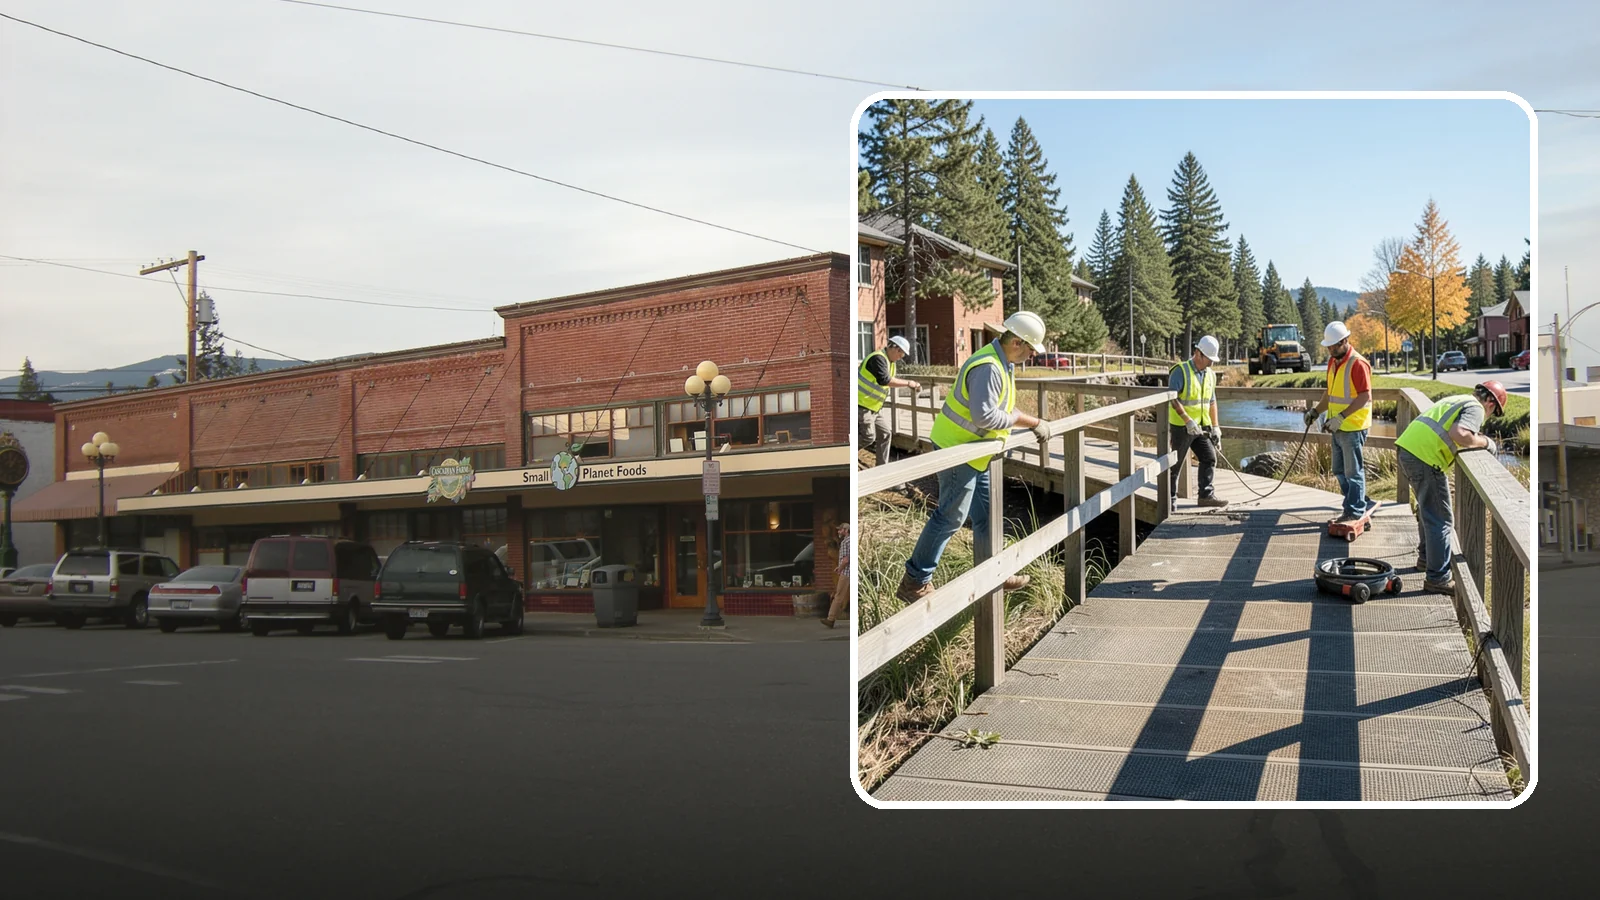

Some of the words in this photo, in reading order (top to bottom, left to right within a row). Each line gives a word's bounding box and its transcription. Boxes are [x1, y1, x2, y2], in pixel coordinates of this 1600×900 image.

[523, 472, 548, 482] Small
[582, 468, 614, 479] Planet
[616, 464, 646, 477] Foods
